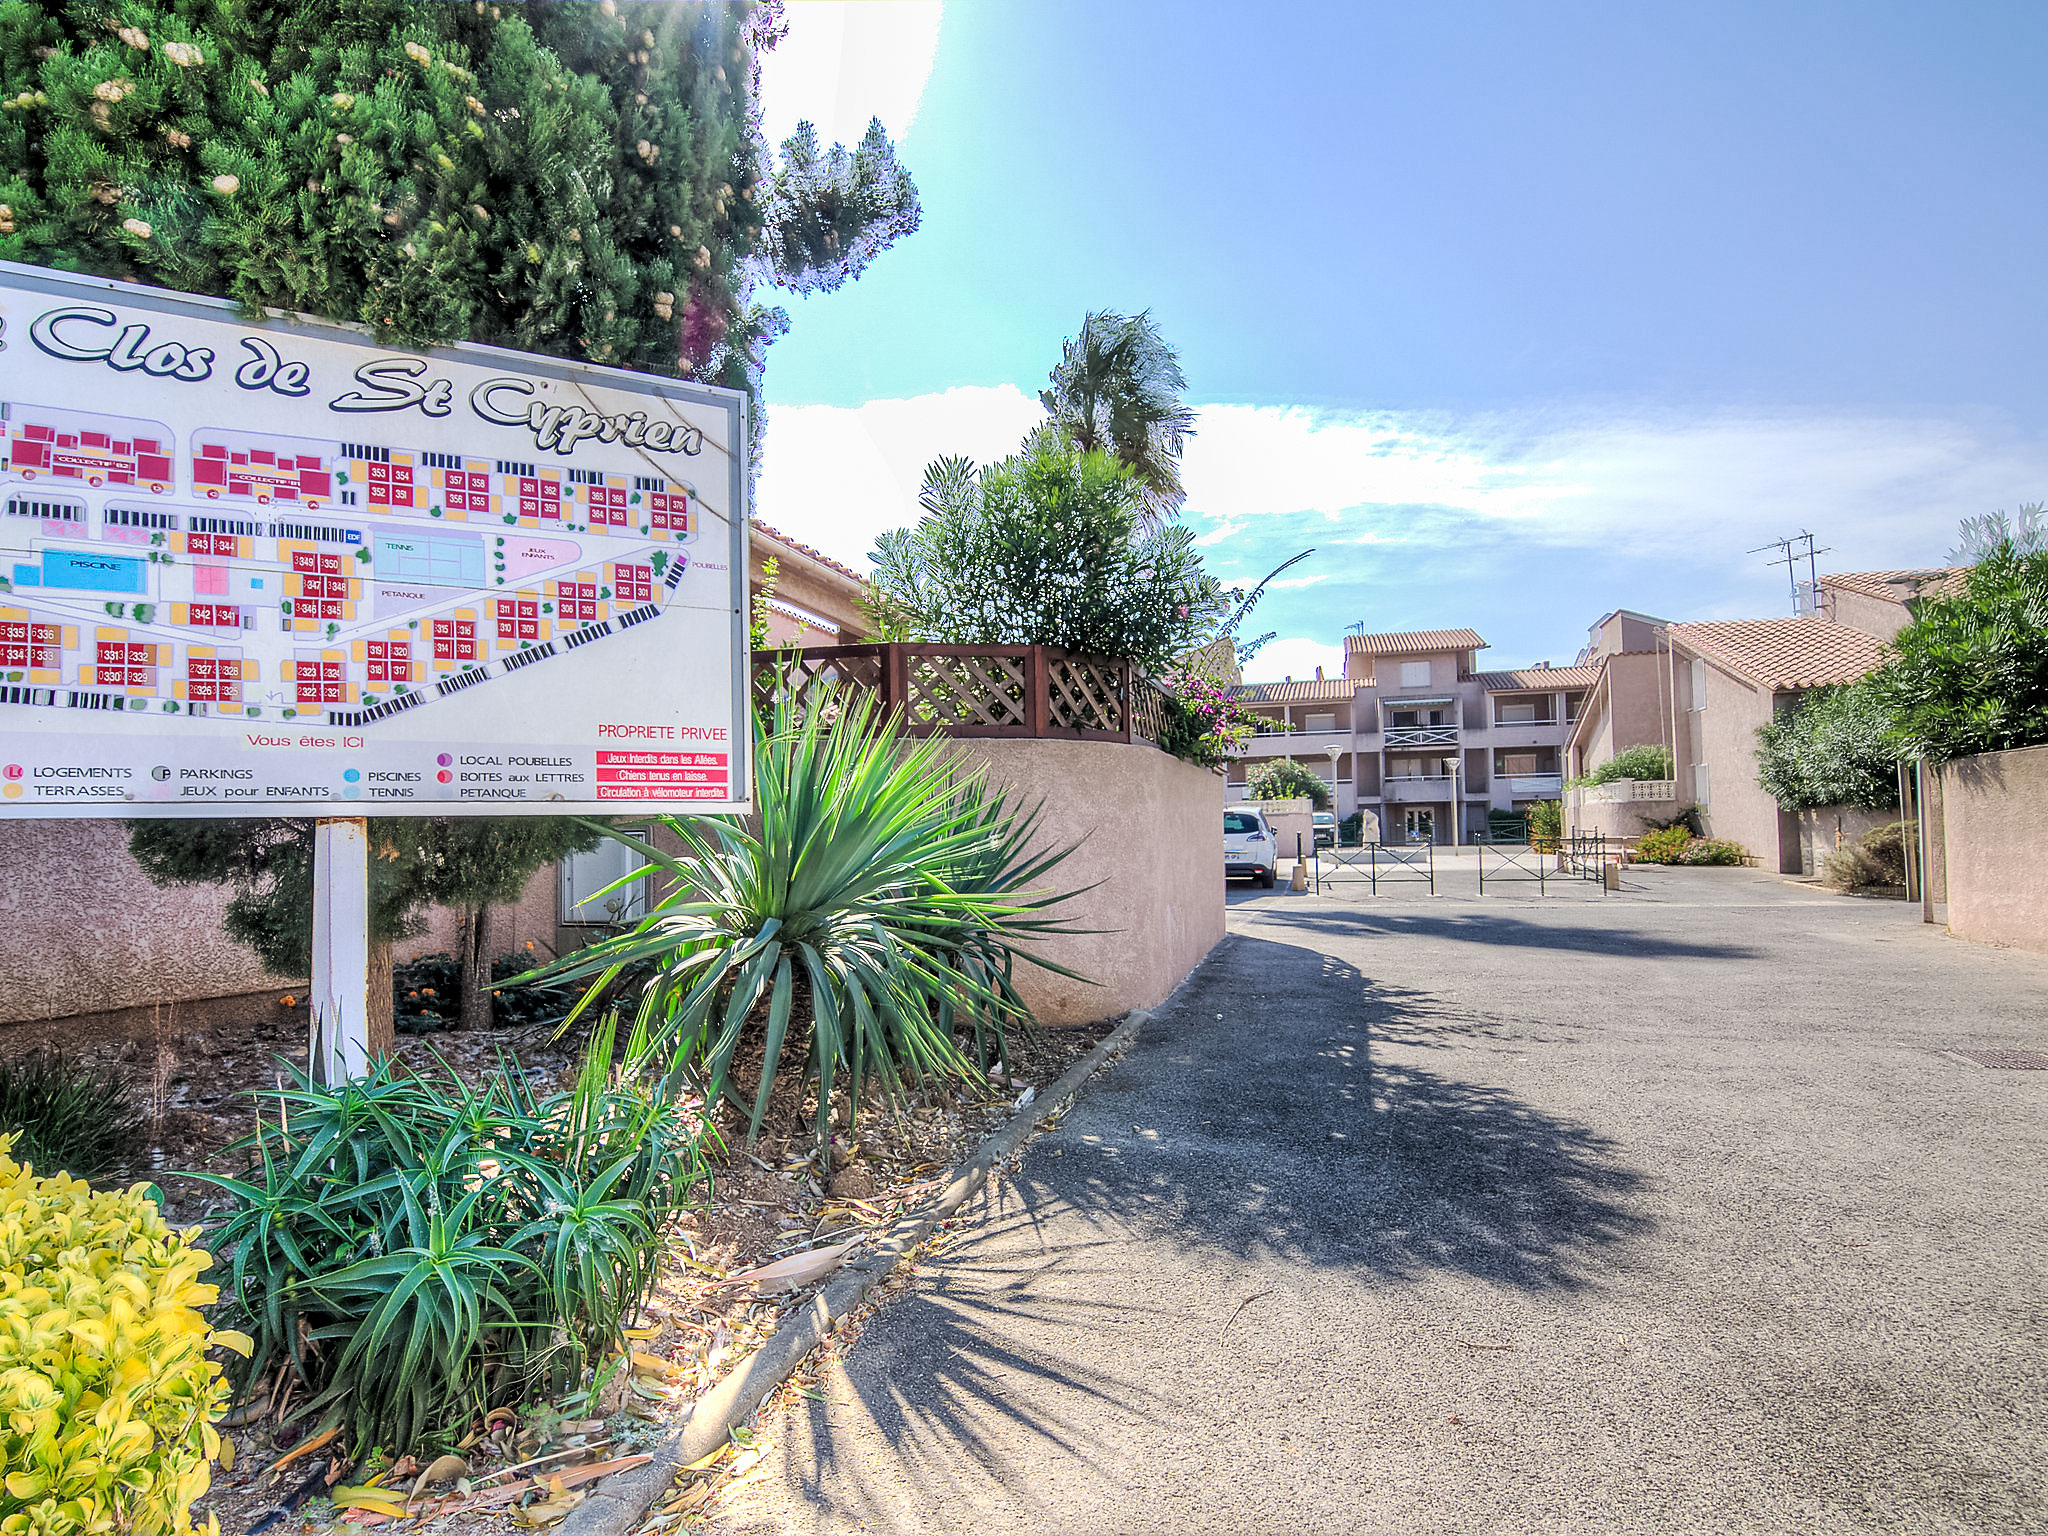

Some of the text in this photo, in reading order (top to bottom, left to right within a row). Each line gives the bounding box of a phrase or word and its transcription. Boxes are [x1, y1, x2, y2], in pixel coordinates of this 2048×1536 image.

[30, 307, 215, 382] Clos
[235, 337, 310, 397] de
[329, 358, 451, 417] St
[469, 377, 703, 456] Cyprien
[372, 468, 386, 478] 353
[396, 470, 409, 480] 354
[450, 475, 462, 485] 357
[472, 478, 485, 488] 358
[372, 487, 386, 497] 352
[522, 483, 535, 493] 361
[544, 486, 556, 496] 362
[396, 489, 407, 499] 351
[450, 494, 462, 504] 356
[592, 492, 604, 502] 365
[612, 494, 624, 504] 366
[472, 496, 485, 506] 355
[522, 501, 536, 511] 360
[654, 498, 666, 508] 369
[672, 500, 684, 510] 370
[544, 503, 556, 513] 359
[592, 509, 604, 519] 364
[612, 512, 624, 521] 363
[654, 515, 666, 524] 368
[672, 517, 684, 526] 367
[347, 533, 361, 541] EDF
[385, 543, 414, 551] TENNIS
[70, 560, 121, 570] PISCINE
[300, 556, 313, 567] 349
[324, 558, 338, 569] 350
[692, 561, 728, 571] POUBELLES
[618, 568, 630, 578] 303
[638, 570, 650, 580] 304
[381, 590, 426, 599] PETANQUE
[560, 586, 573, 595] 307
[582, 588, 594, 598] 308
[618, 586, 630, 595] 302
[638, 588, 649, 597] 301
[499, 604, 510, 613] 311
[521, 606, 533, 616] 312
[560, 604, 573, 613] 306
[582, 605, 594, 615] 305
[194, 609, 210, 620] 342
[7, 627, 24, 638] 335
[437, 624, 449, 634] 315
[499, 623, 511, 632] 310
[521, 624, 534, 634] 309
[37, 628, 54, 639] 336
[394, 646, 407, 656] 320
[437, 643, 449, 652] 314
[460, 644, 471, 653] 313
[6, 650, 23, 660] 334
[132, 651, 148, 662] 332
[196, 665, 211, 675] 327
[302, 667, 317, 677] 323
[394, 666, 406, 675] 317
[104, 672, 120, 682] 330
[132, 672, 148, 682] 329
[196, 686, 211, 695] 326
[302, 688, 316, 697] 322
[598, 724, 728, 740] PROPRIETE PRIVEE
[247, 734, 363, 748] Vous êtes ICI
[460, 756, 572, 767] LOCAL POUBELLES
[607, 753, 626, 763] Jeux
[660, 755, 678, 764] dans
[681, 756, 692, 764] les
[34, 767, 132, 778] LOGEMENTS
[180, 769, 253, 779] PARKINGS
[369, 772, 422, 782] PISCINES
[460, 772, 502, 782] BOITES
[536, 774, 585, 782] LETTRES
[619, 770, 646, 780] Chiens
[649, 771, 669, 781] tenus
[685, 771, 708, 781] laisse.
[34, 786, 124, 796] TERRASSES
[180, 786, 329, 798] JEUX pour ENFANTS
[369, 788, 414, 797] TENNIS
[460, 788, 526, 798] PETANQUE
[600, 787, 641, 797] Circulation
[644, 788, 649, 797] à
[652, 787, 693, 797] vélomoteur
